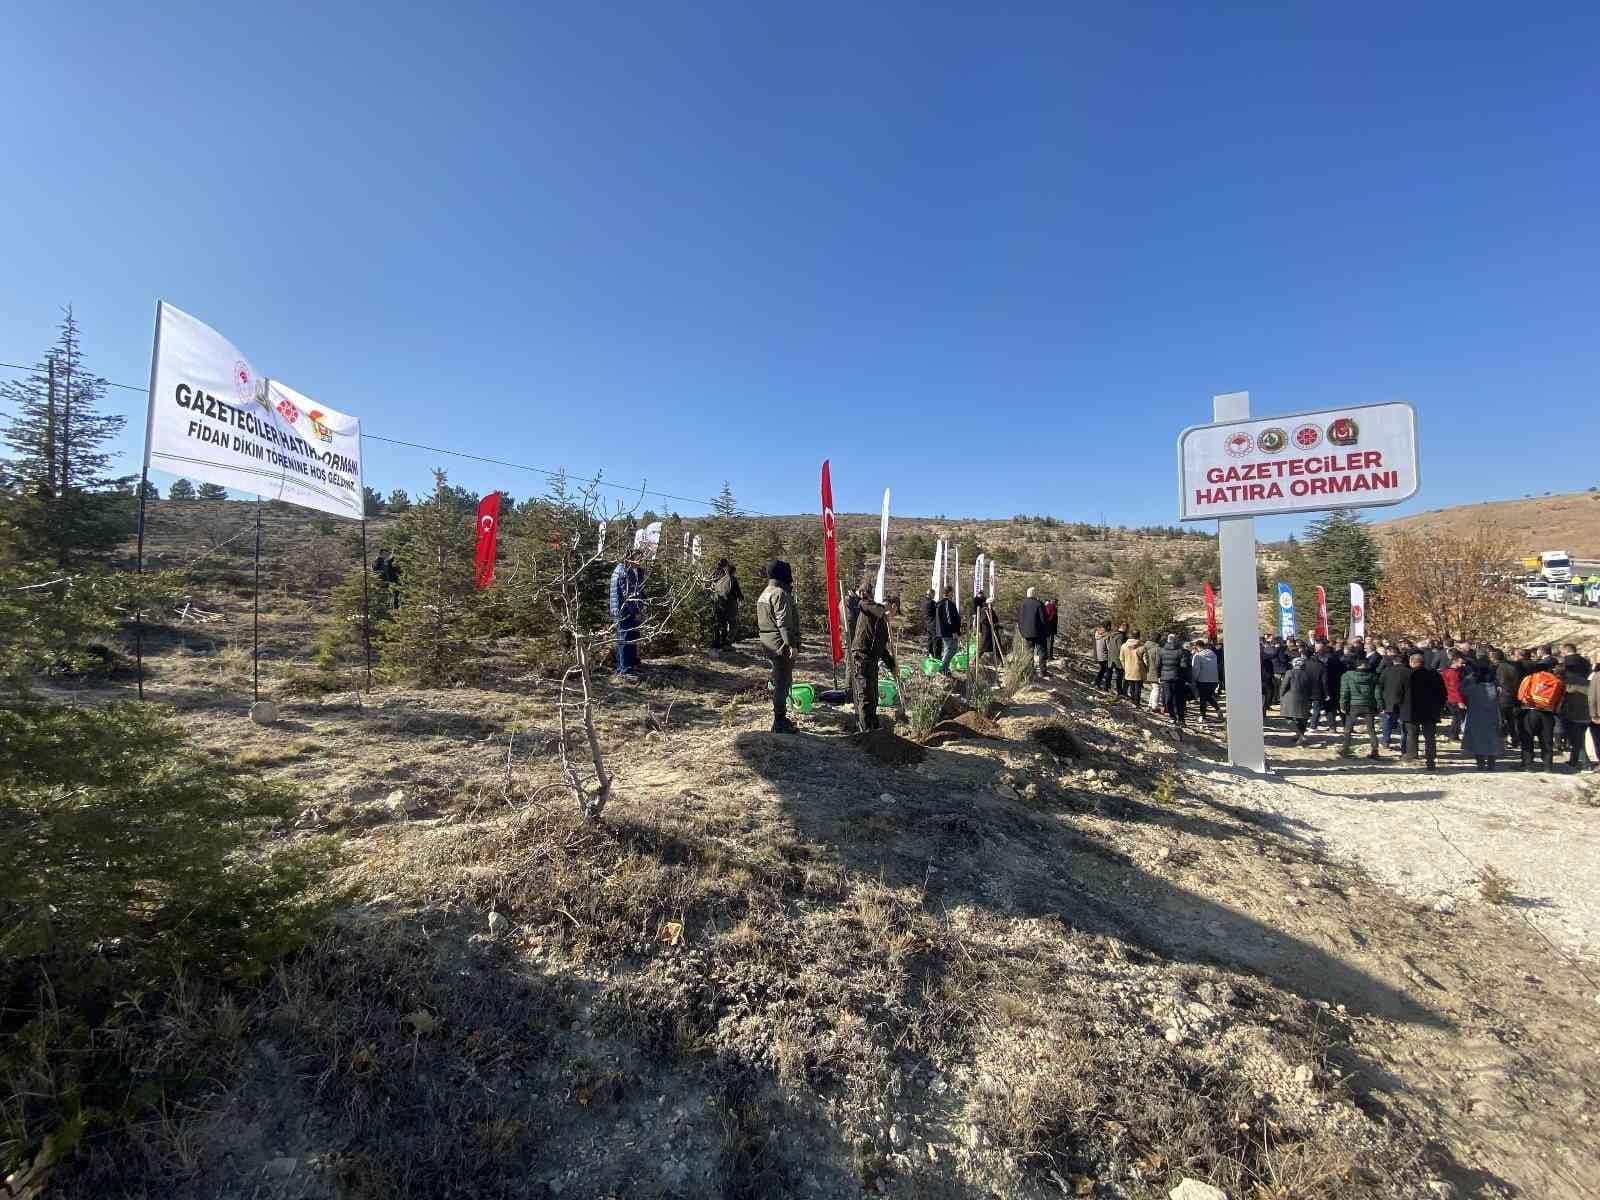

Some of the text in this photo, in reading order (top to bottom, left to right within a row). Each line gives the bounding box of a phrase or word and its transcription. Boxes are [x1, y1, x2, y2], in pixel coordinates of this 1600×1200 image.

[175, 383, 280, 446] GAZETECİLER
[187, 419, 230, 448] FİDAN
[233, 435, 264, 461] DİKİM
[265, 446, 309, 475] TÖRENİNE
[1196, 470, 1398, 505] HATIRA ORMANI
